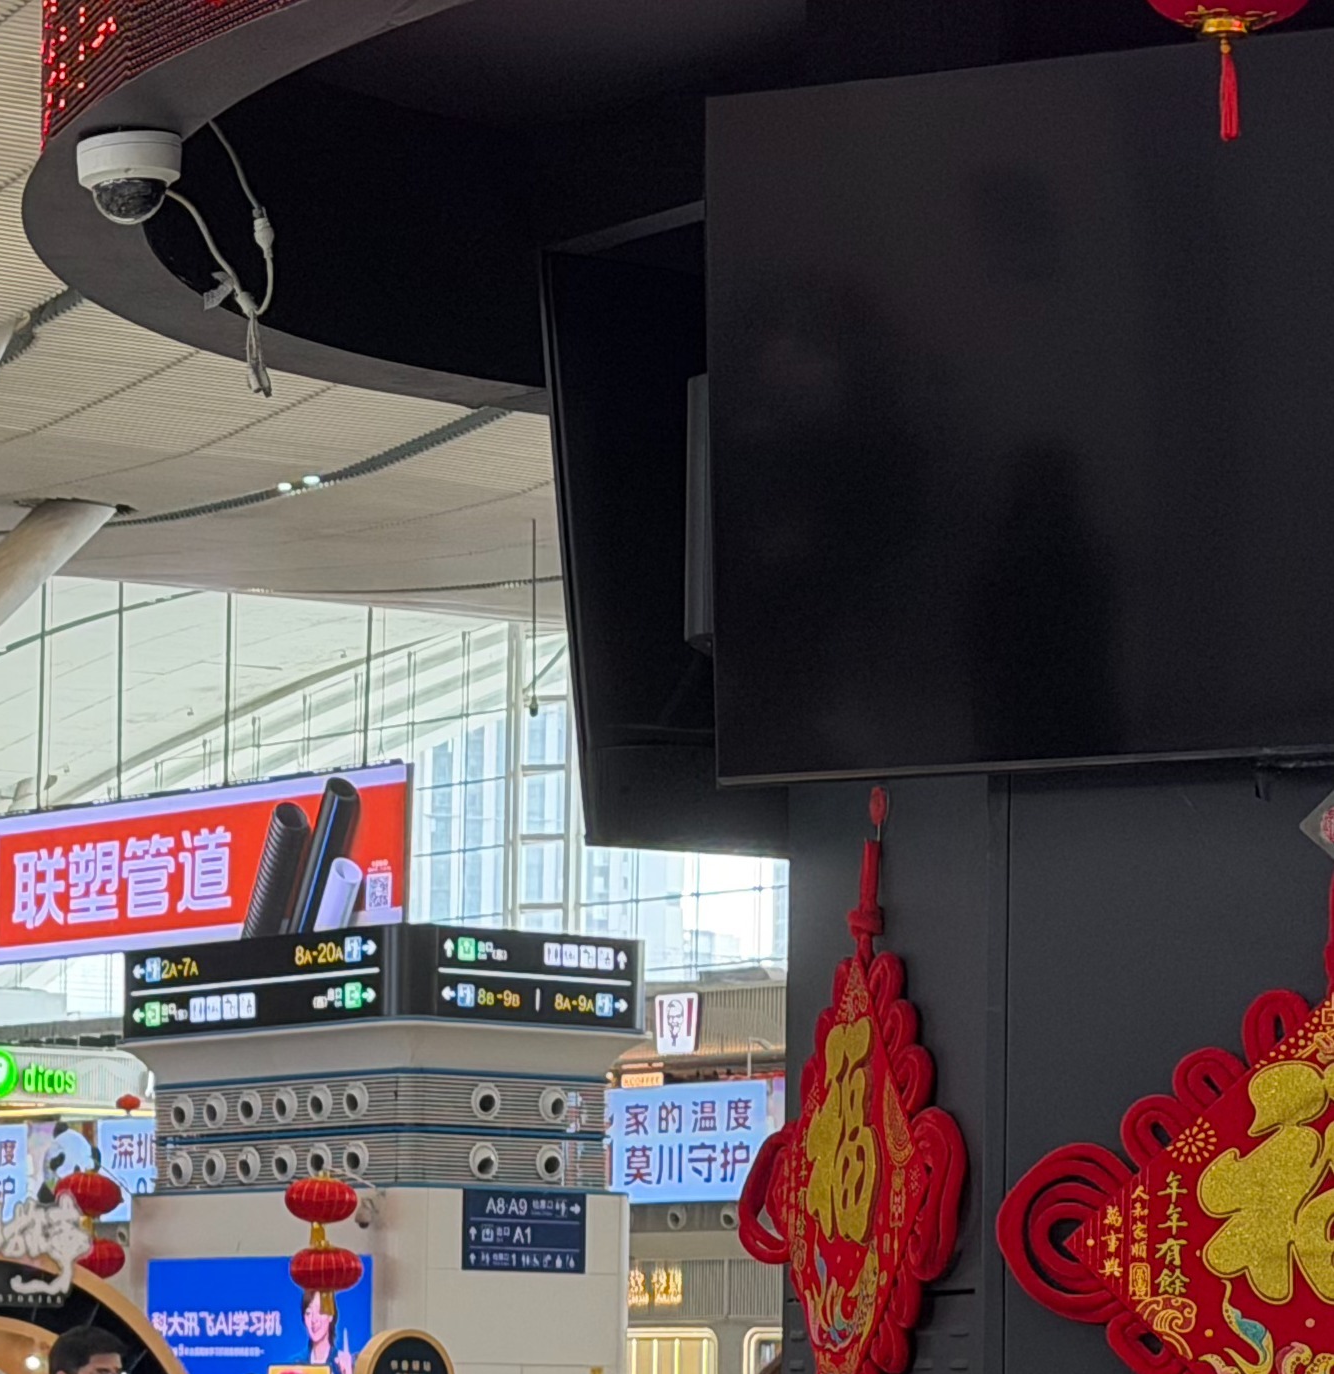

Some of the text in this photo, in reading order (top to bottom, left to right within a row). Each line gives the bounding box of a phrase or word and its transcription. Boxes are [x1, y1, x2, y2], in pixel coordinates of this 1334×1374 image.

[13, 826, 232, 929] 联塑管道
[161, 957, 199, 978] 2A-7A
[294, 942, 343, 966] 8A-20A
[24, 1063, 76, 1094] dicos
[624, 1098, 752, 1136] 家的温度
[806, 1016, 877, 1246] 福
[624, 1141, 750, 1186] 莫川守护
[512, 1225, 531, 1245] A1
[1154, 1171, 1191, 1296] 年年有餘
